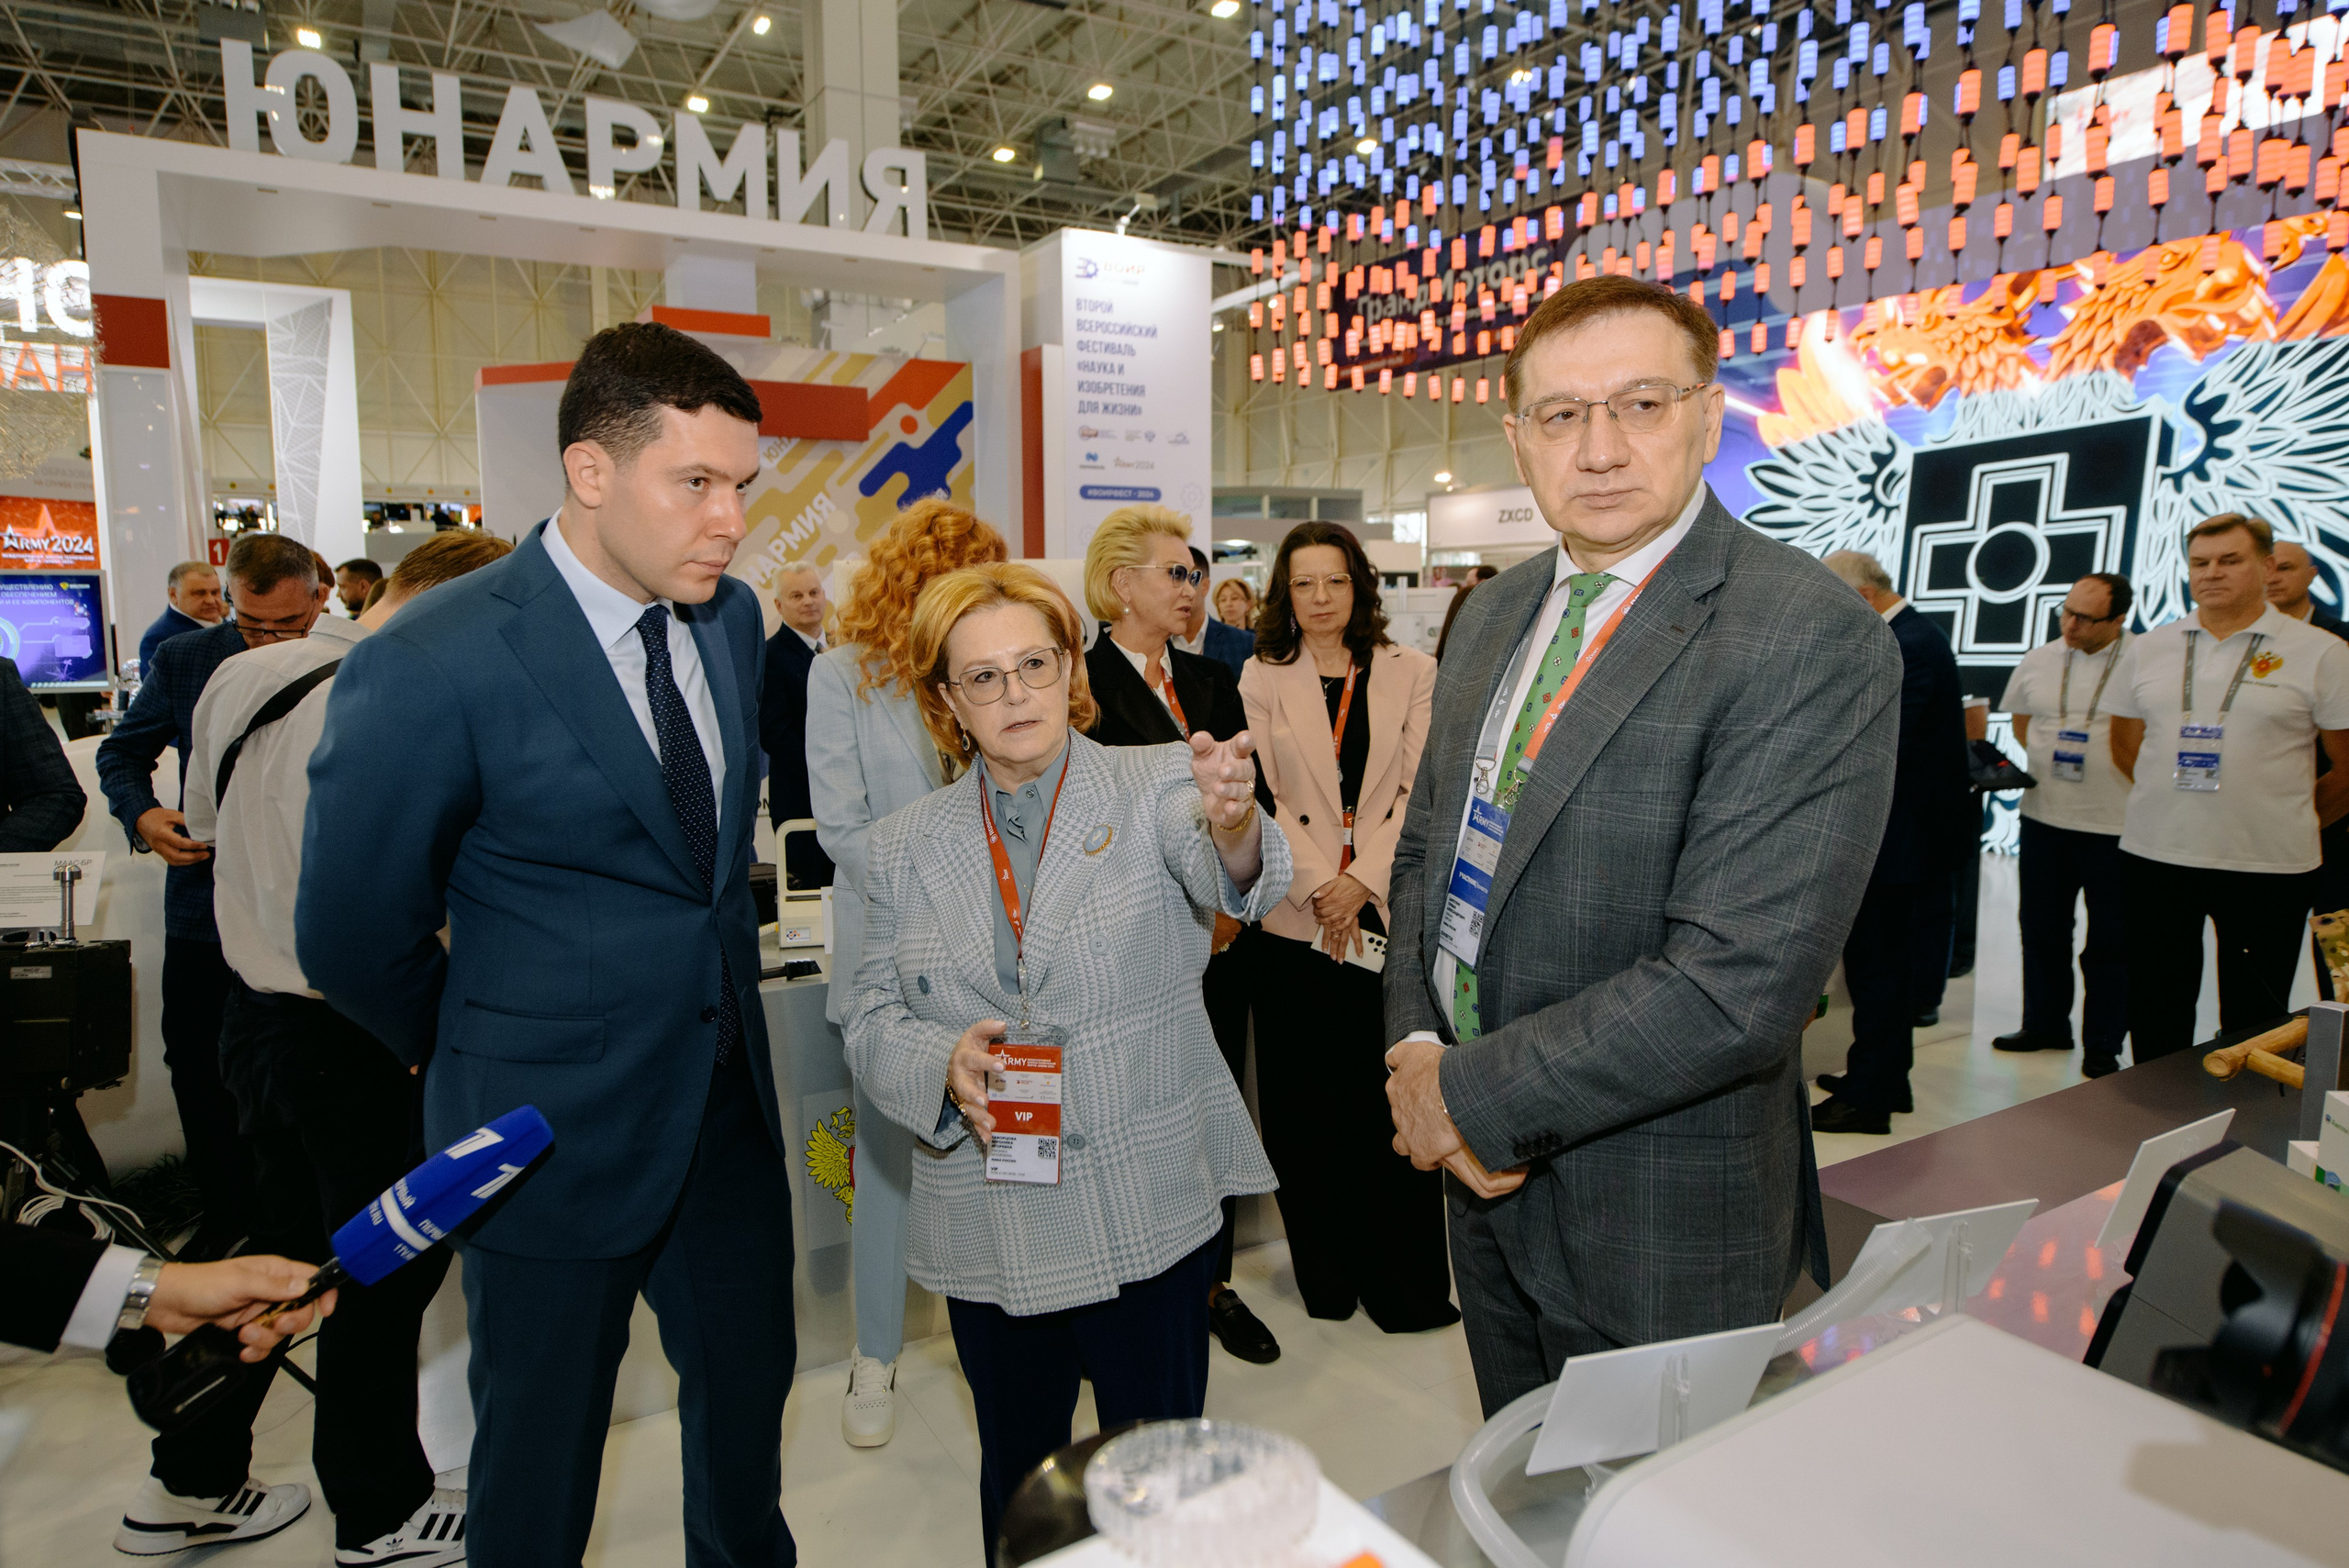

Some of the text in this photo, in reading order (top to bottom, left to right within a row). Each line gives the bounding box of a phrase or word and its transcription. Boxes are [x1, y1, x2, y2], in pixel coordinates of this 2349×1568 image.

[220, 38, 928, 239] ЮНАРМИЯ
[1075, 297, 1114, 314] ВТОРОЙ
[1076, 318, 1158, 339] ВСЕРОССИЙСКИЙ
[1076, 339, 1137, 357] ФЕСТИВАЛЬ
[1077, 360, 1125, 375] «НАУКА И
[1077, 379, 1146, 397] ИЗОБРЕТЕНИЯ
[1077, 400, 1143, 417] ДЛЯ ЖИЗНИ»
[1498, 507, 1533, 523] ZXCD
[213, 541, 223, 563] 1
[1015, 1111, 1033, 1122] VIP
